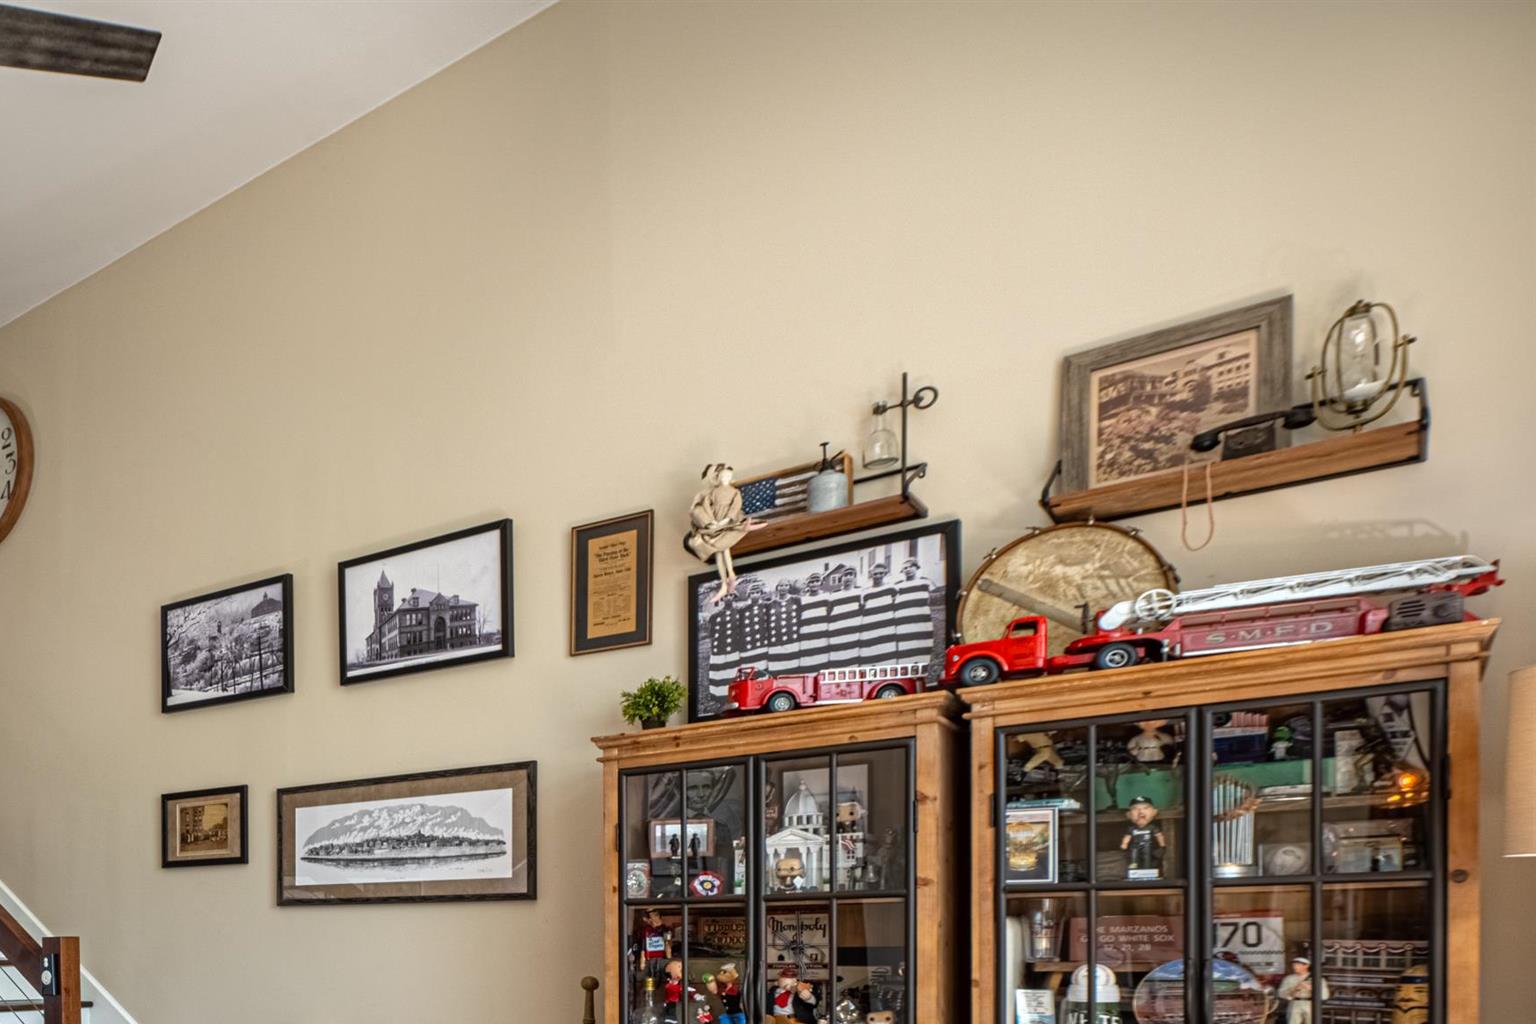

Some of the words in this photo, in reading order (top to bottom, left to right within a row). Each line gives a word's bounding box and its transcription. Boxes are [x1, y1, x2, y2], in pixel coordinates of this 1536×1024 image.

[1, 427, 13, 450] 2
[5, 451, 17, 475] 3
[0, 480, 12, 500] 4
[767, 916, 827, 938] Monpoly
[1109, 925, 1169, 933] MARZANOS
[1098, 935, 1116, 943] GO
[1153, 934, 1175, 942] SOX
